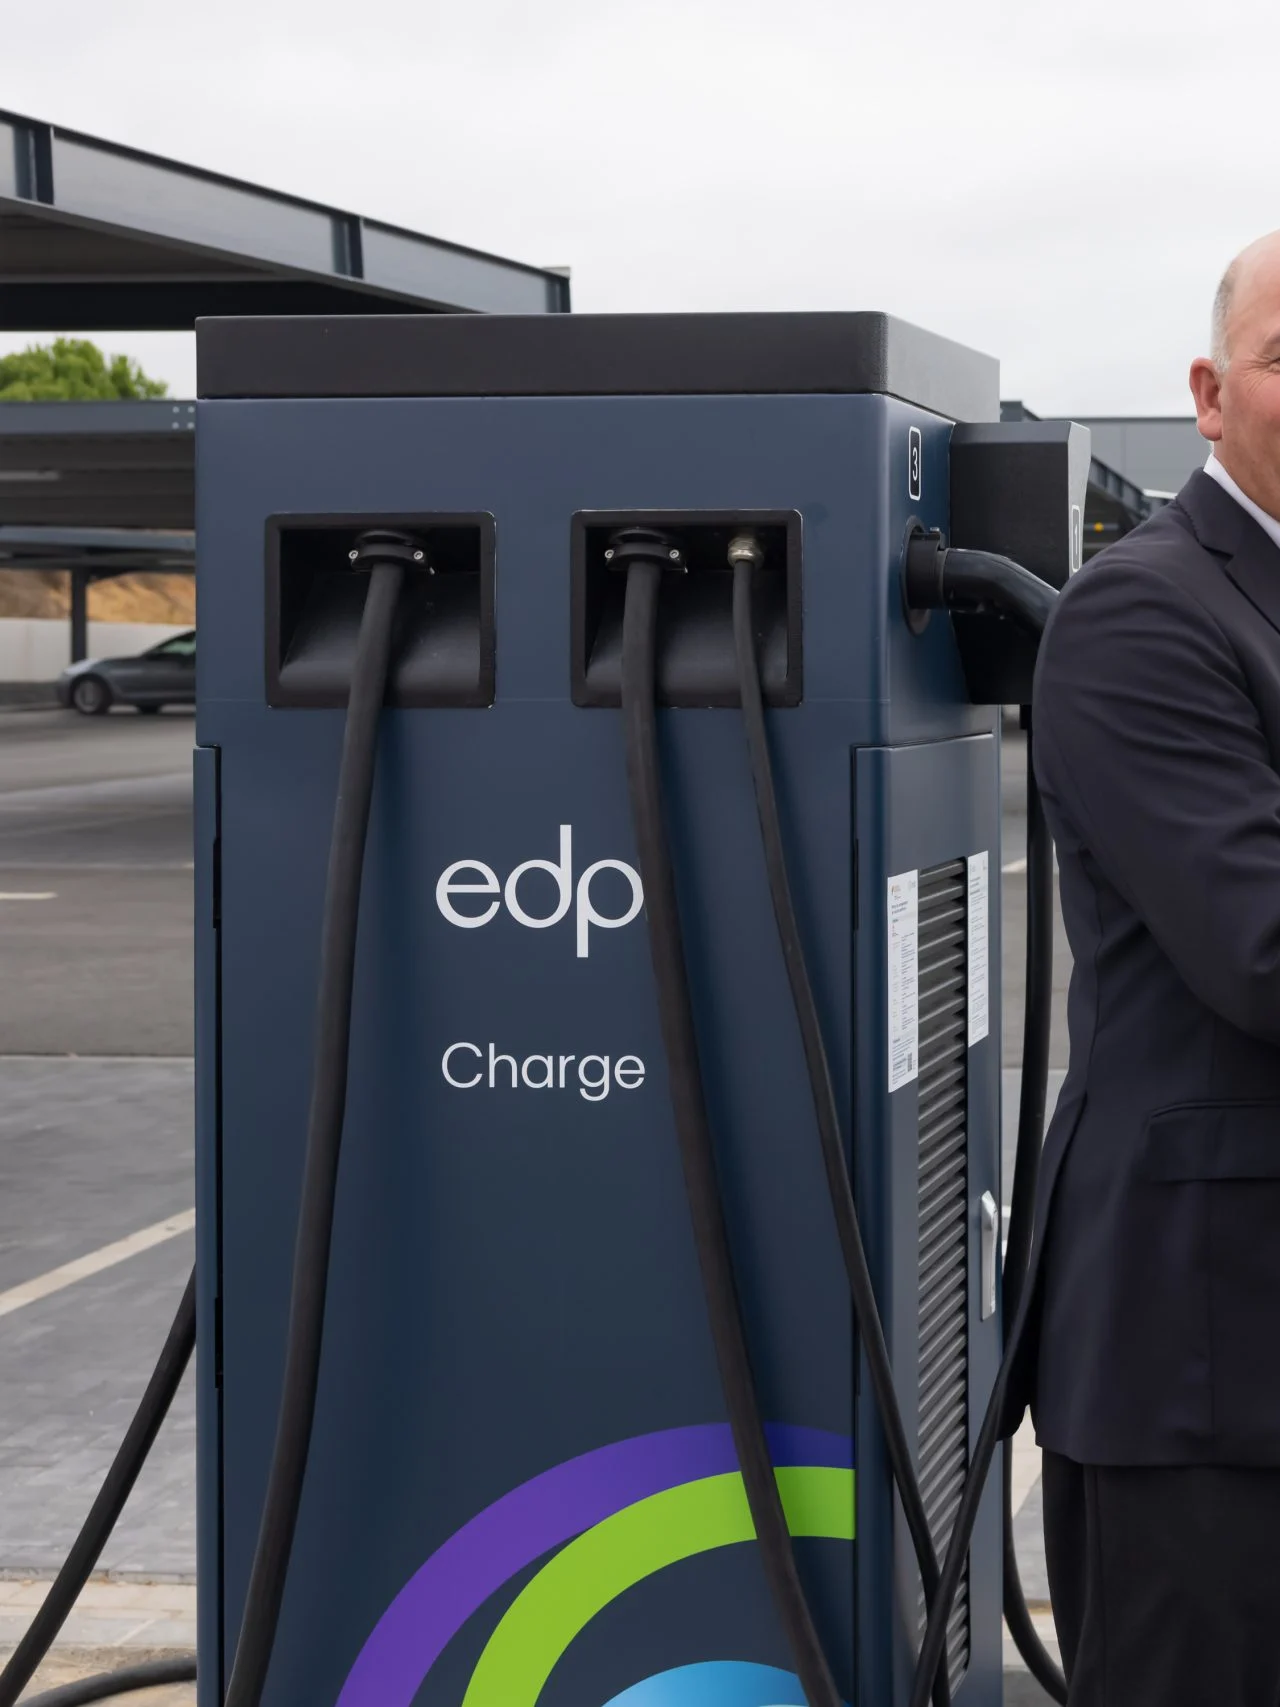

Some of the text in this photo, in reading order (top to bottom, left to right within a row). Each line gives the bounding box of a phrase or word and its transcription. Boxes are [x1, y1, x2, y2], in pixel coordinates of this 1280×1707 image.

[912, 447, 918, 481] 3
[436, 824, 644, 958] edp
[441, 1042, 646, 1101] Charge
